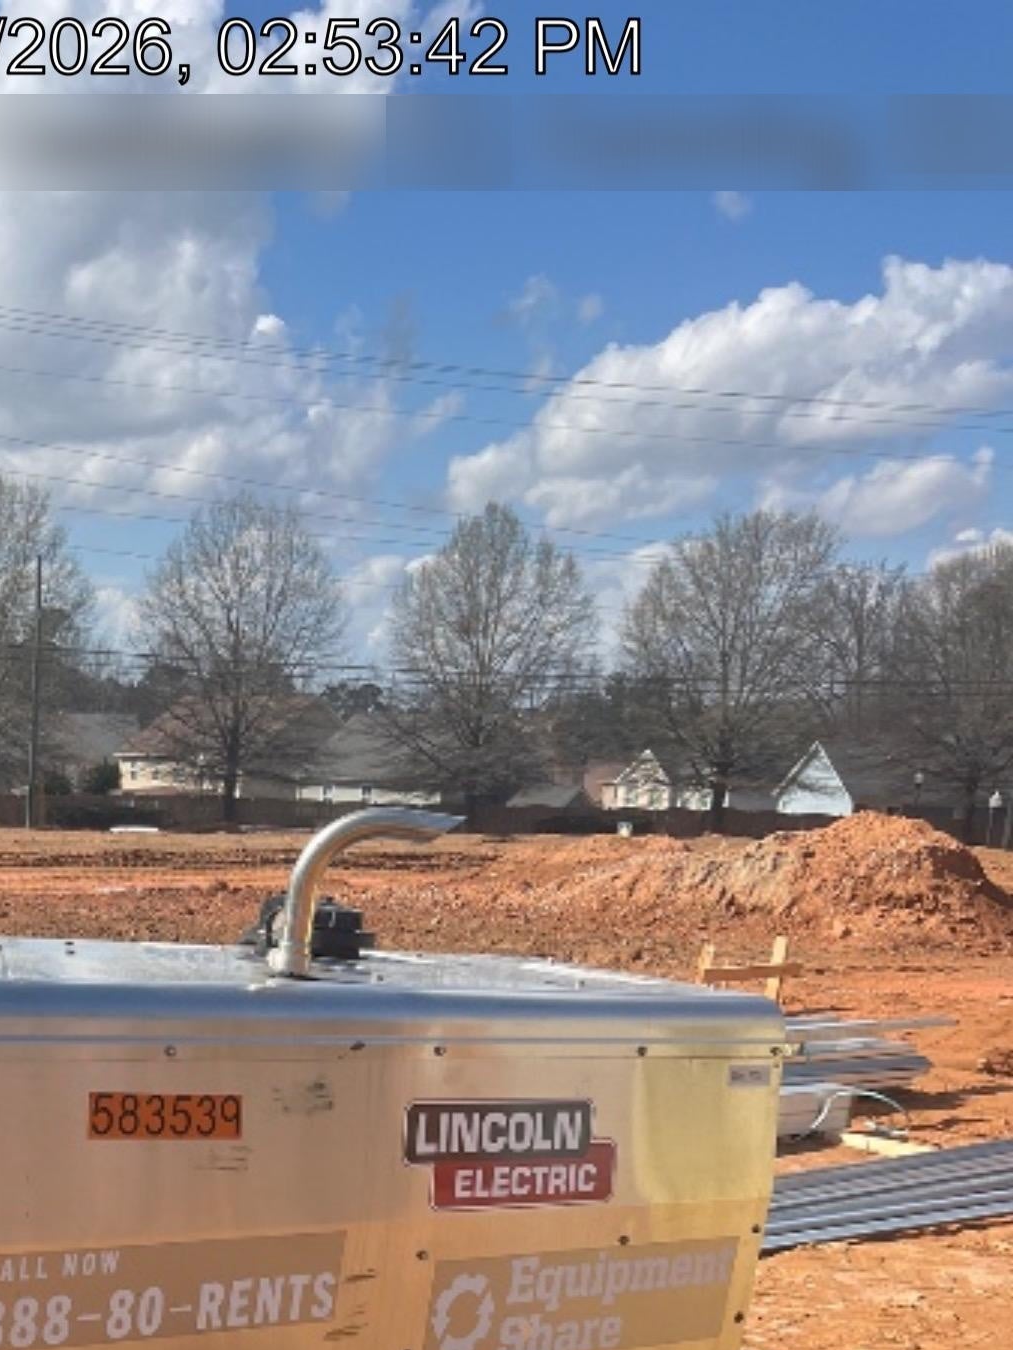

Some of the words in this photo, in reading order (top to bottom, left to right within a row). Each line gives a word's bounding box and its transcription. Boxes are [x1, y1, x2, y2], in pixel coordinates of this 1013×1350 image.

[91, 1093, 241, 1137] 583539
[415, 1110, 583, 1156] LINCOLN
[454, 1163, 598, 1199] ELECTRIC
[61, 1250, 120, 1278] NOW
[506, 1246, 737, 1309] Equipment
